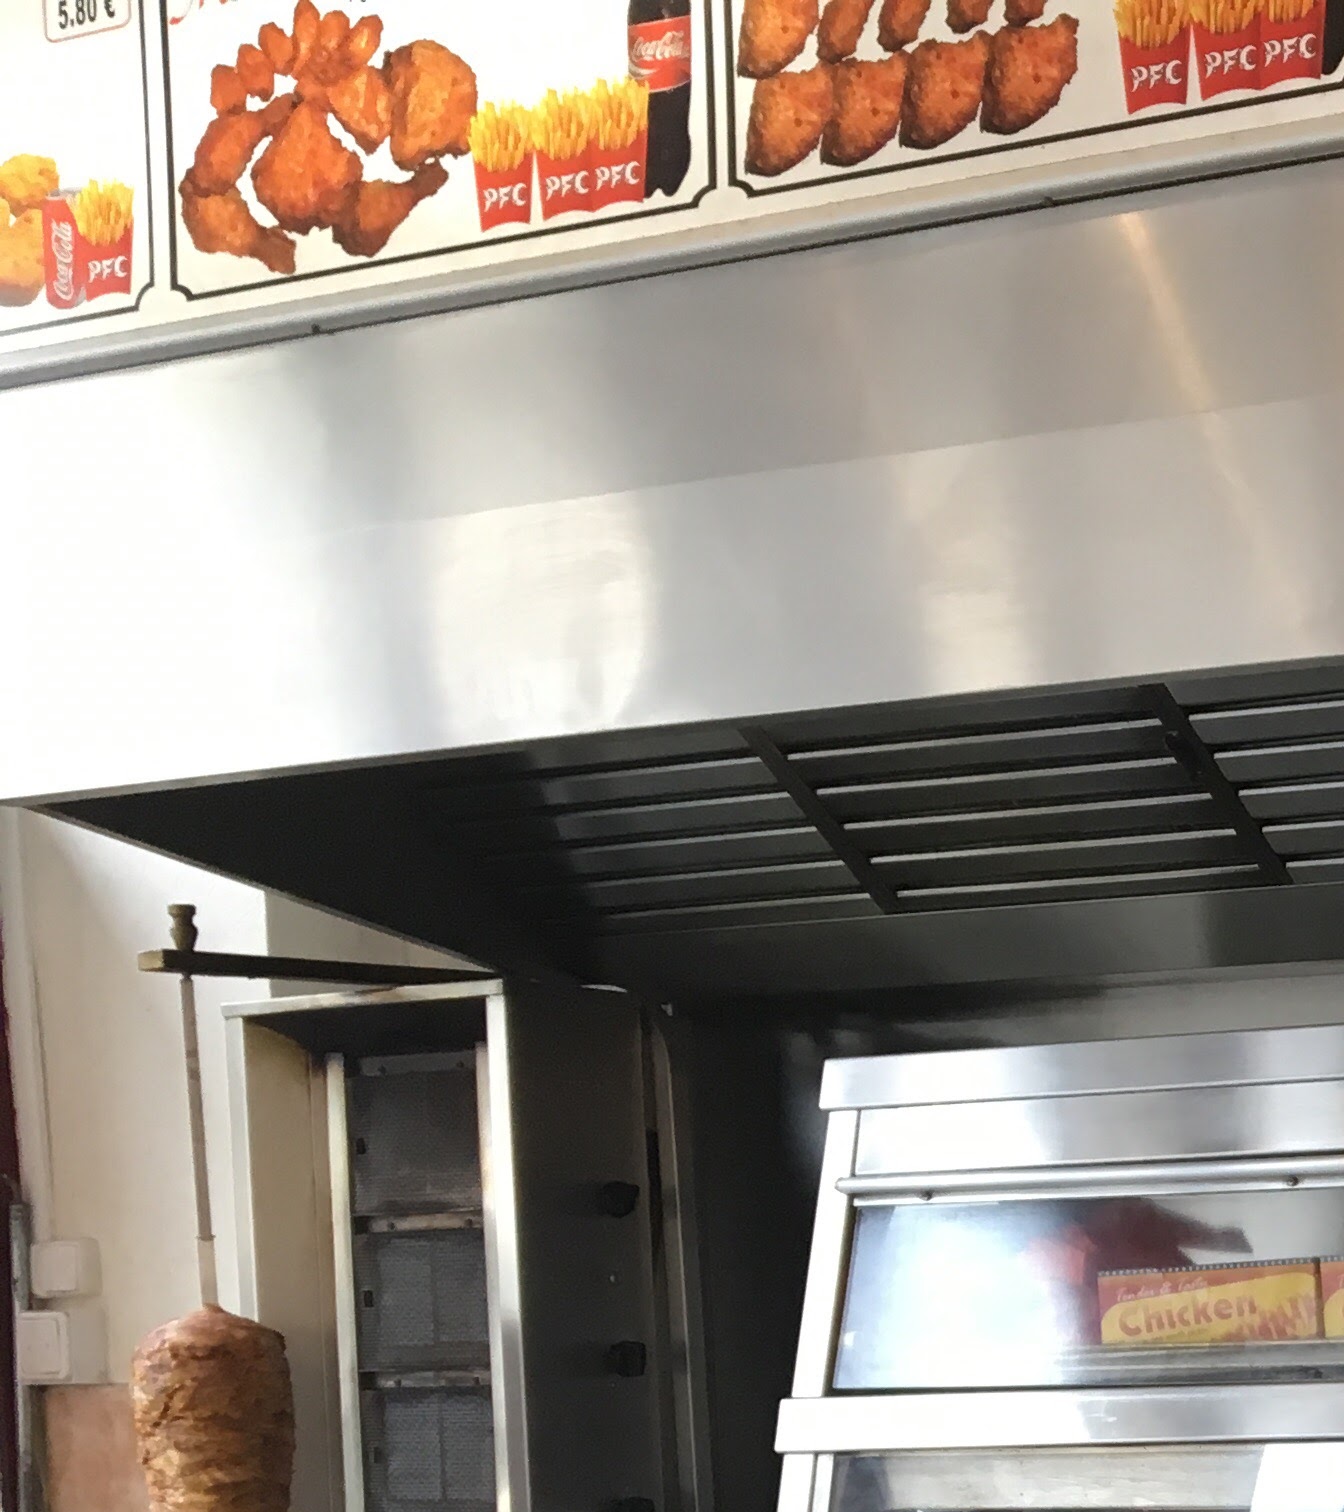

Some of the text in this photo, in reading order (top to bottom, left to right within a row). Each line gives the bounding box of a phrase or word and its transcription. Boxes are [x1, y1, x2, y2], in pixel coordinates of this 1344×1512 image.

[1131, 33, 1317, 93] PFC PFC PFC
[483, 160, 641, 213] PFC PFC PFC
[87, 255, 129, 284] PFC
[1118, 1292, 1258, 1338] Chicken
